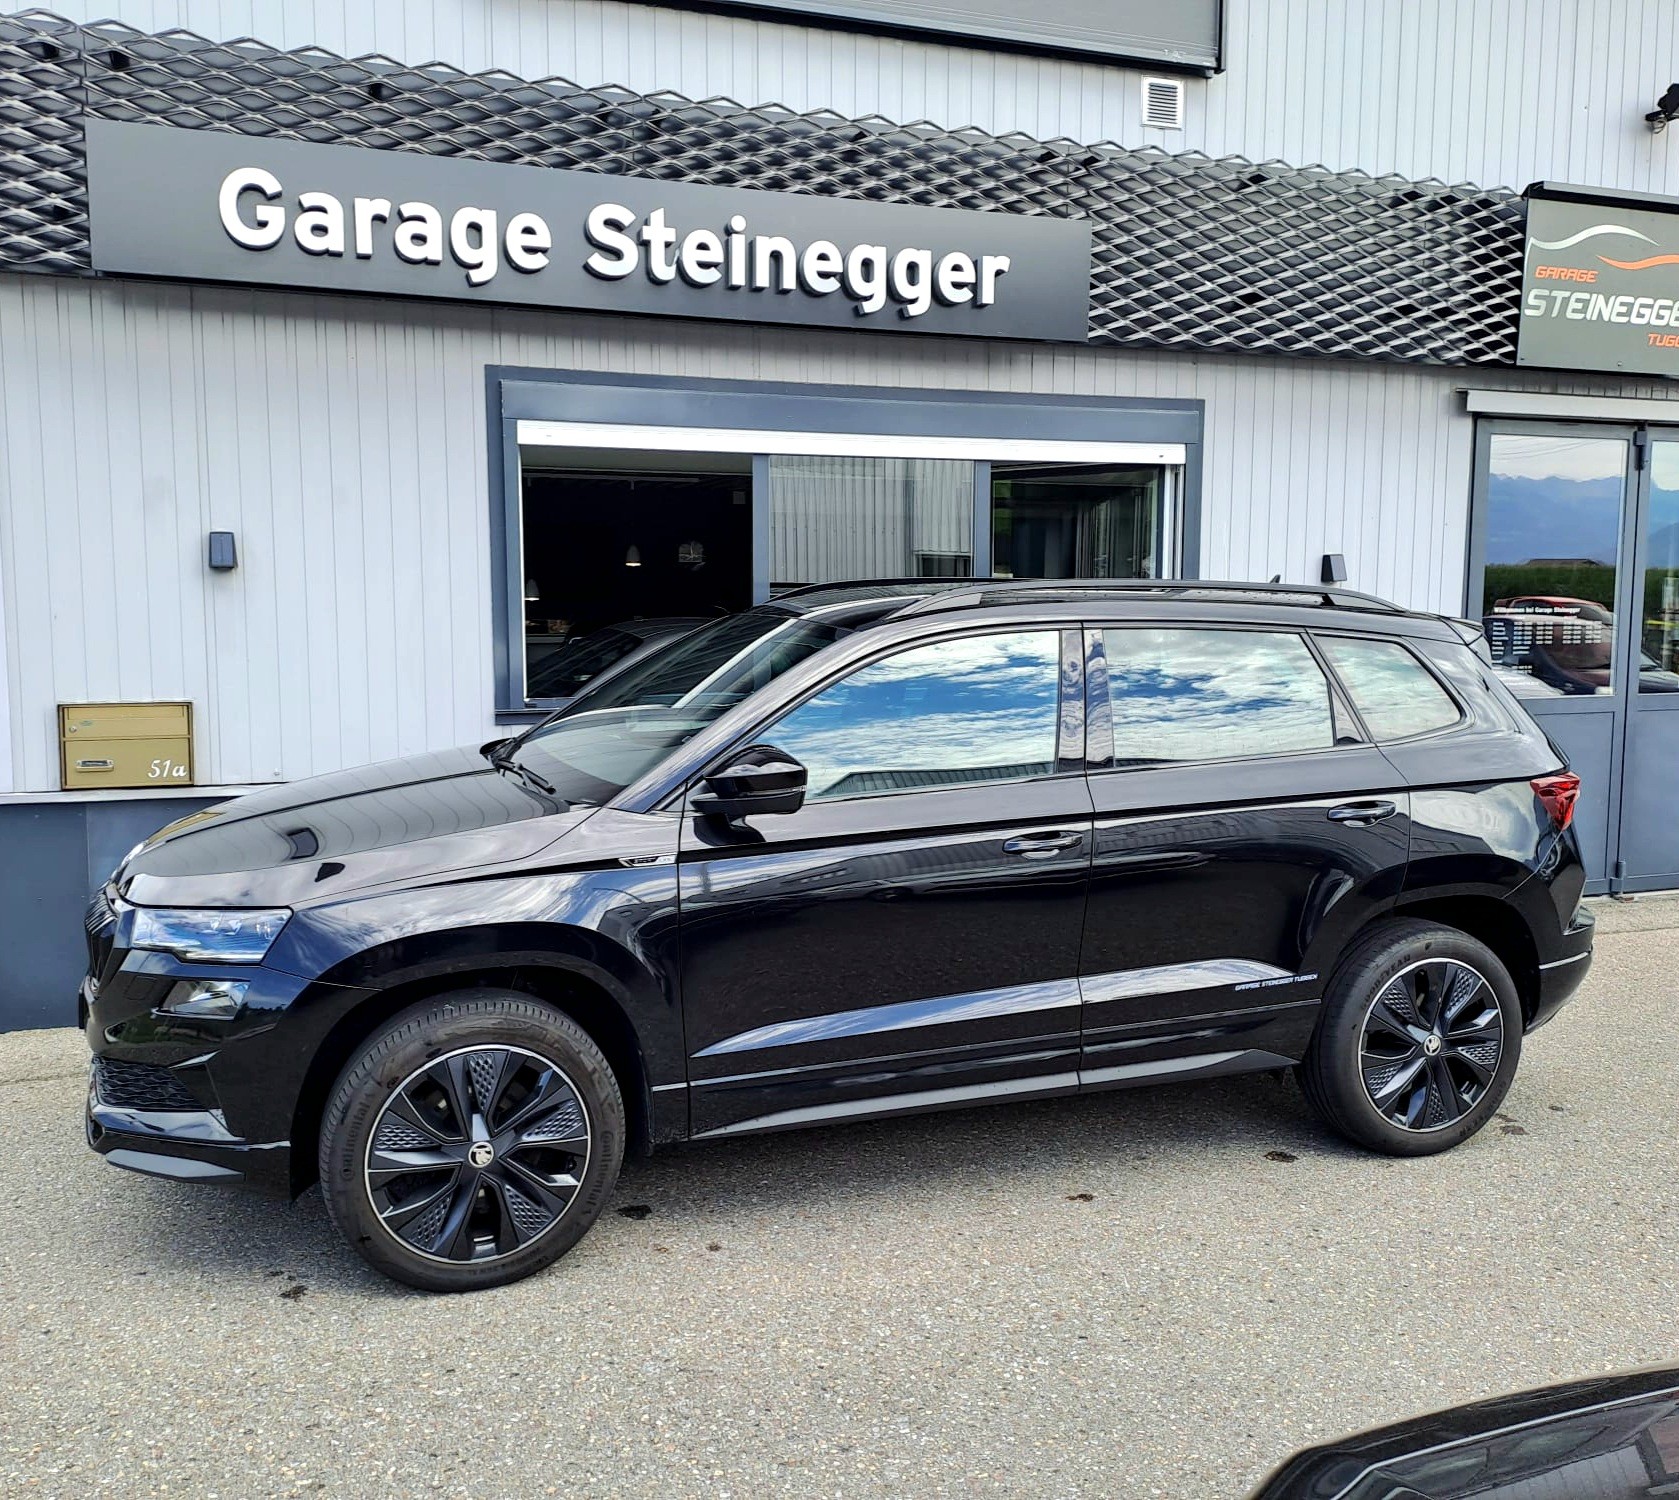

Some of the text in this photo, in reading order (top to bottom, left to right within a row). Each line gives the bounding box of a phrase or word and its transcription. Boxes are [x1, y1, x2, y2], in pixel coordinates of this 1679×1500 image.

[218, 167, 1011, 317] Garage Steinegger
[1534, 265, 1599, 283] GARAGE
[147, 759, 187, 778] 51a
